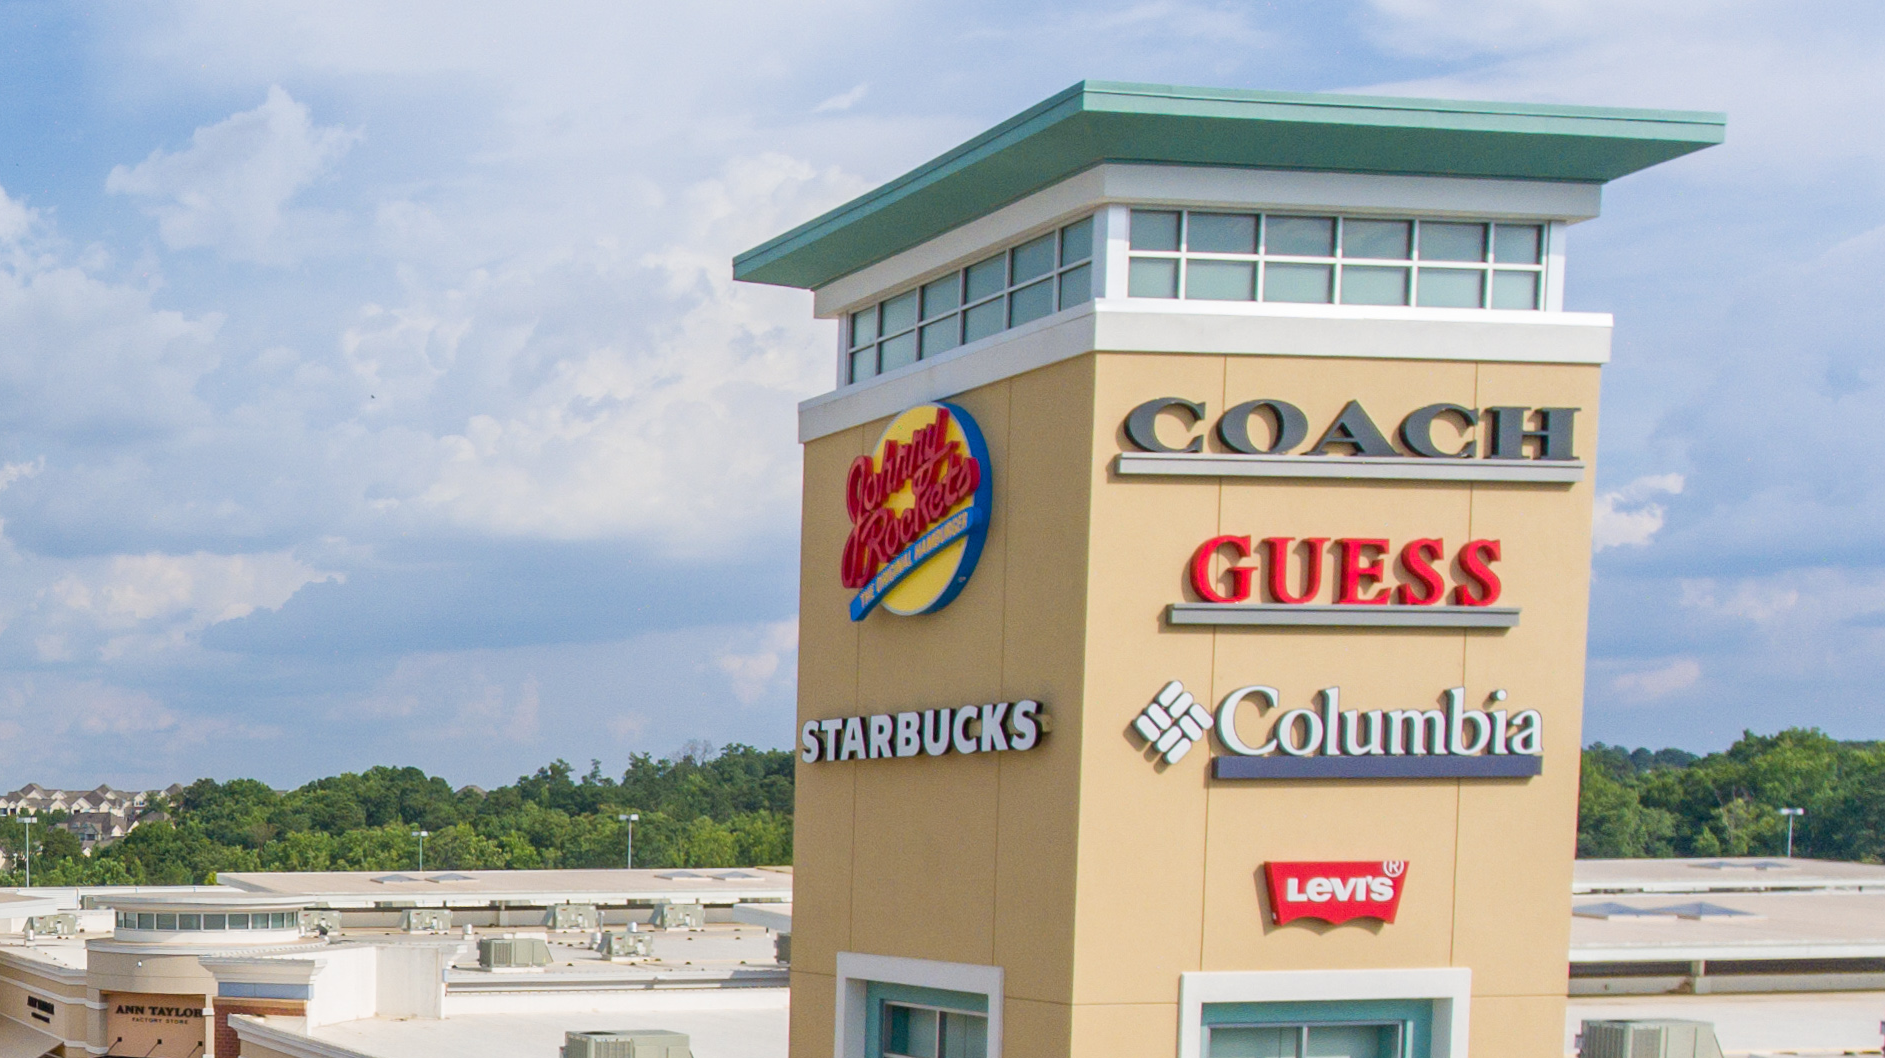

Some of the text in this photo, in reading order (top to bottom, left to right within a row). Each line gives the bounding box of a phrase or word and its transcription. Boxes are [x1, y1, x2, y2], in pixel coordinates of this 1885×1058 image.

[1124, 397, 1582, 460] COACH
[843, 408, 961, 585] Johnny
[854, 452, 982, 588] Rockets
[1189, 534, 1502, 607] GUESS
[801, 699, 1041, 764] STARBUCKS
[1218, 685, 1544, 756] Columbia
[116, 1005, 203, 1018] ANN TAYLOR
